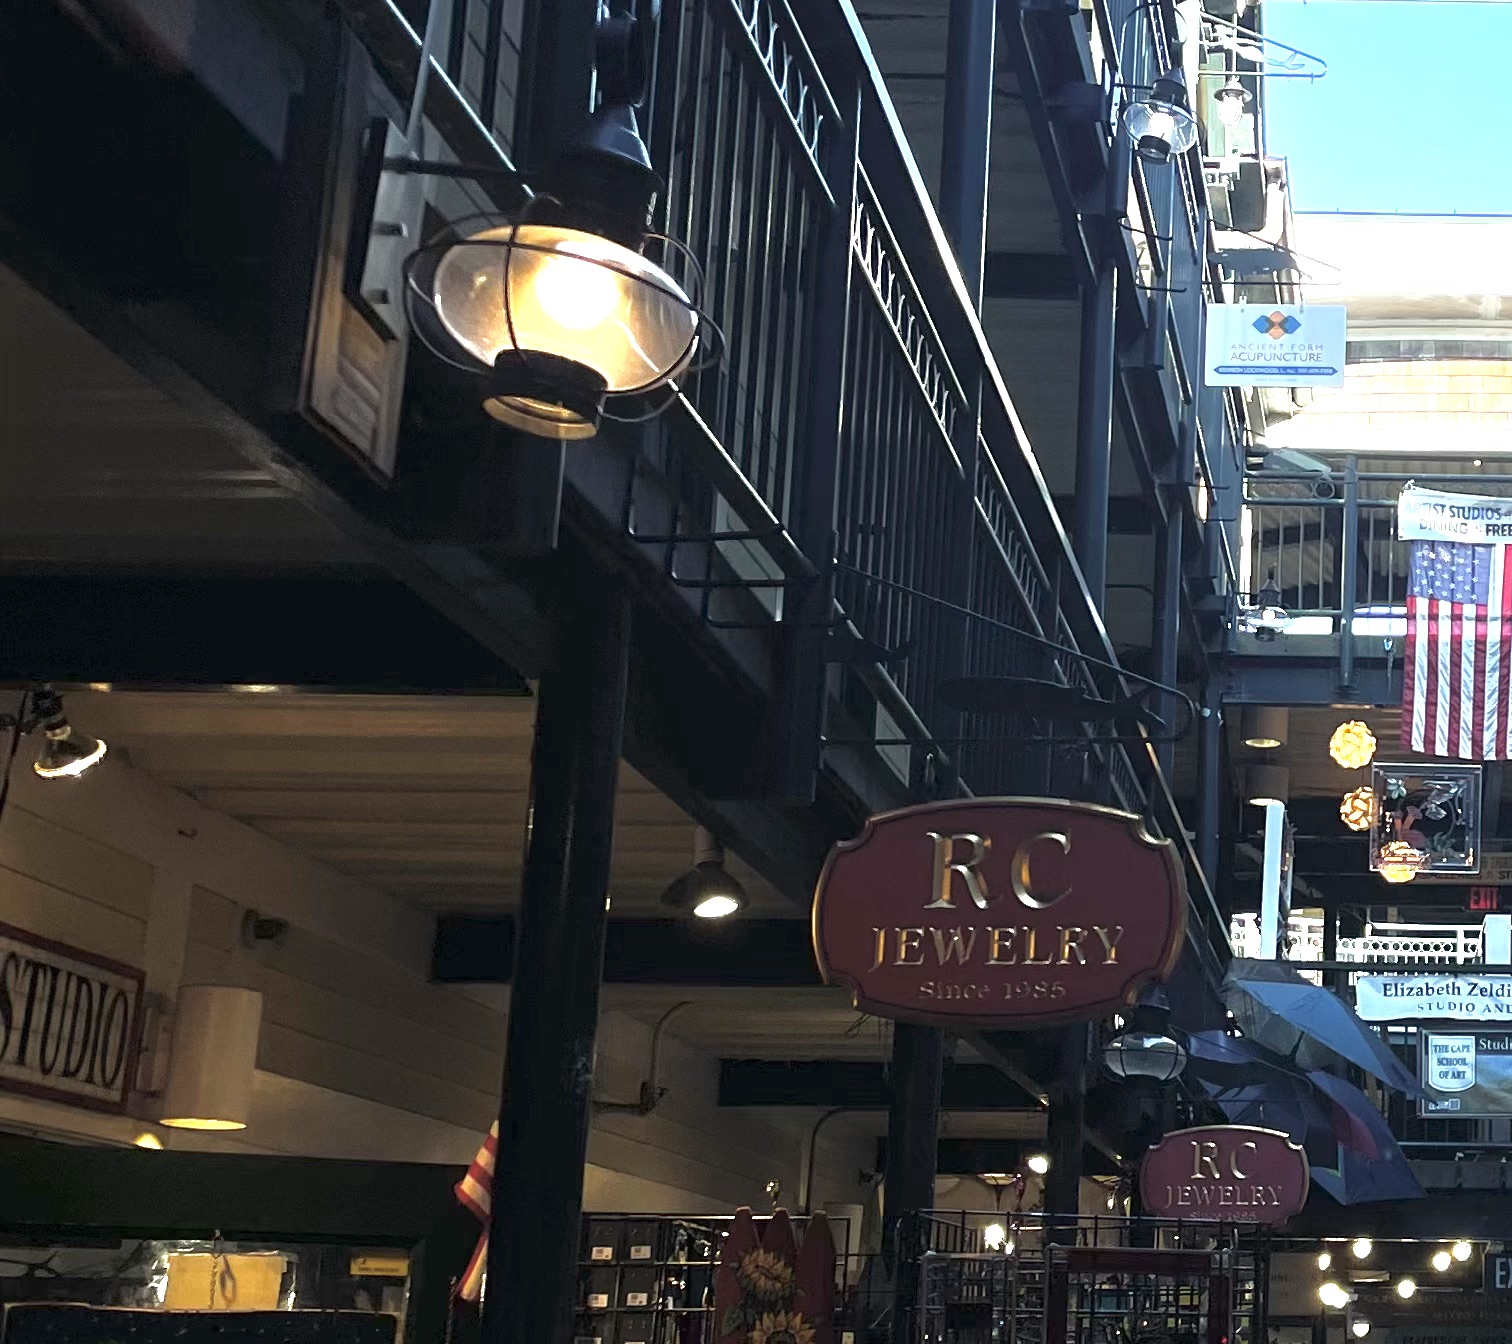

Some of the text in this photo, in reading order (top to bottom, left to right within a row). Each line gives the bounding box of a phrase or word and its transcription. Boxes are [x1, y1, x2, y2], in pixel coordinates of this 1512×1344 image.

[1230, 343, 1323, 351] ANCIENT FORM
[1230, 352, 1323, 362] ACUPUNCTURE
[1449, 504, 1500, 521] STUDIOS
[1470, 886, 1499, 910] EXIT
[867, 925, 1124, 973] JEWELRY
[919, 980, 991, 1000] Since
[1383, 982, 1461, 998] Elizabeth
[1417, 1001, 1476, 1013] STUDIO
[0, 951, 129, 1089] STUDIO
[1433, 1044, 1471, 1054] THE CAPE
[1437, 1057, 1468, 1067] SCHOOL
[1438, 1070, 1467, 1080] OF ART
[1164, 1185, 1282, 1209] JEWELRY
